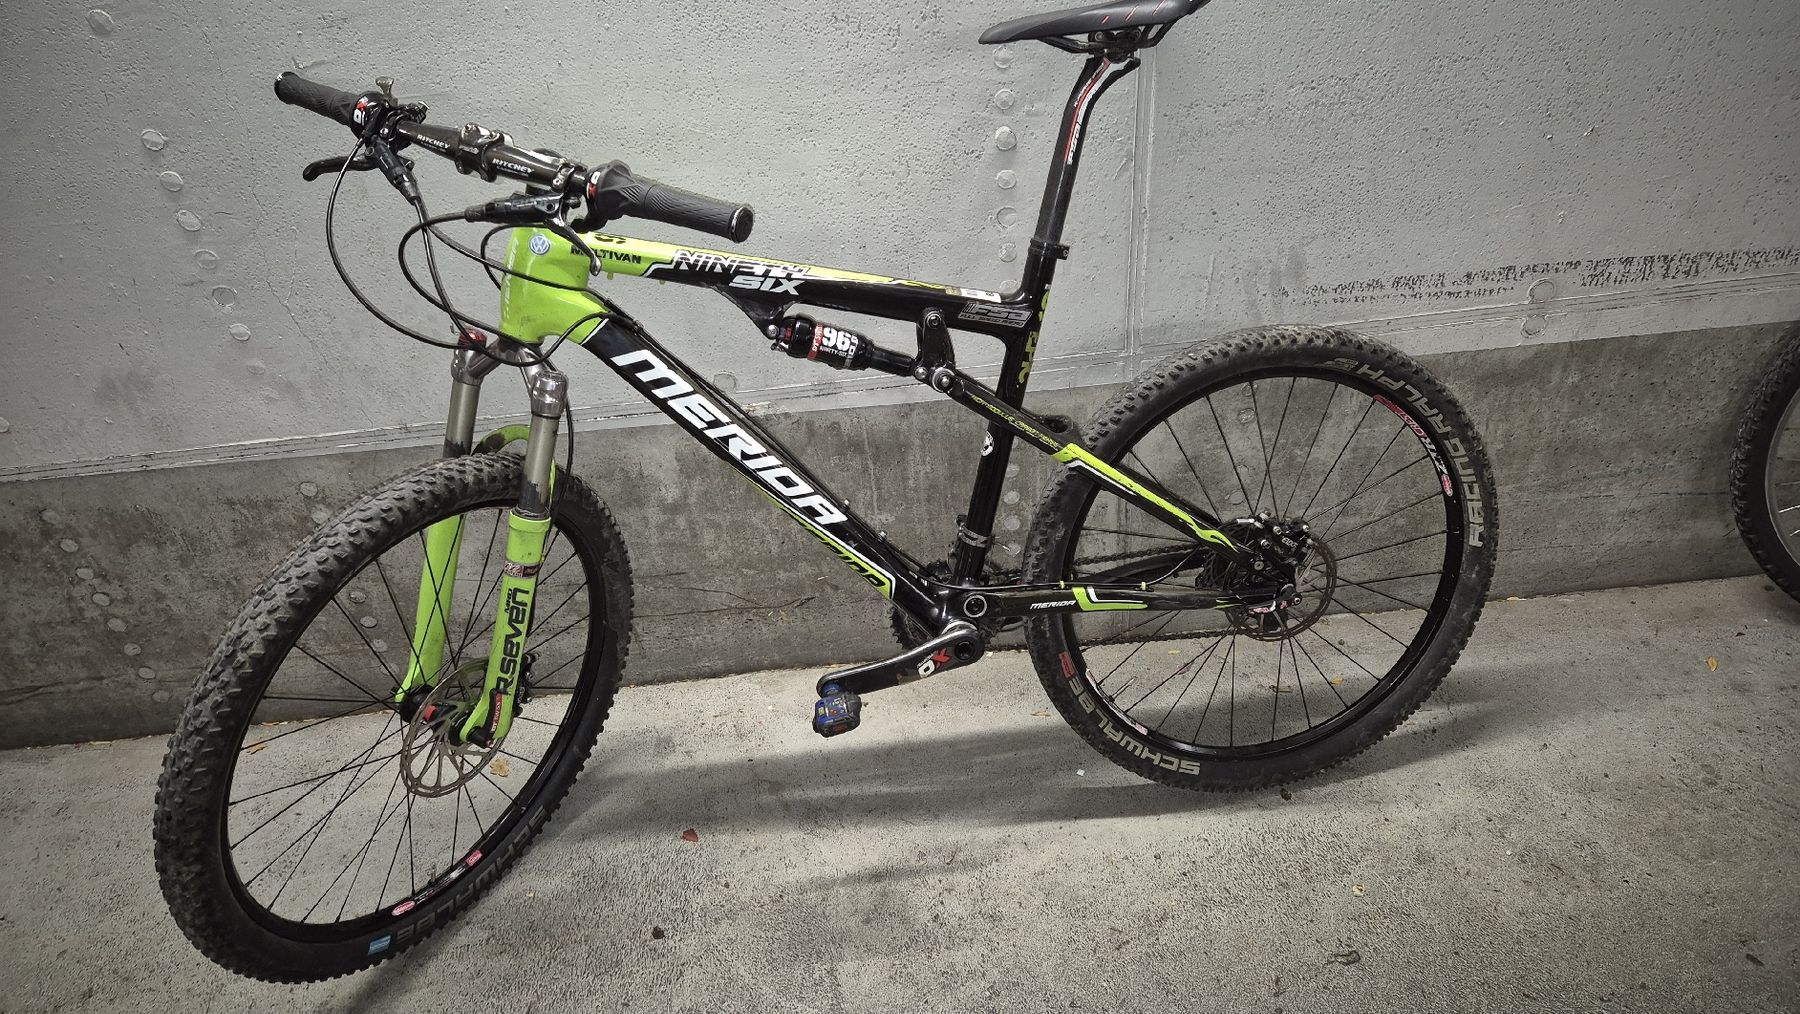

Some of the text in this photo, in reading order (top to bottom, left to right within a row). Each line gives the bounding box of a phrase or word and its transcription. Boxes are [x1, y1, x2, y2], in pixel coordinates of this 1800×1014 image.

[416, 133, 451, 150] RITCHEY
[492, 158, 534, 174] RITCHEY
[671, 249, 812, 277] NINETY
[729, 275, 805, 295] SIX
[821, 327, 852, 351] 96
[610, 349, 848, 525] MERIDA
[1357, 364, 1484, 547] RACING RALPH
[1029, 599, 1077, 610] MERIDA
[1068, 676, 1200, 776] SCHWALBE
[395, 804, 547, 941] SCHWALBE
